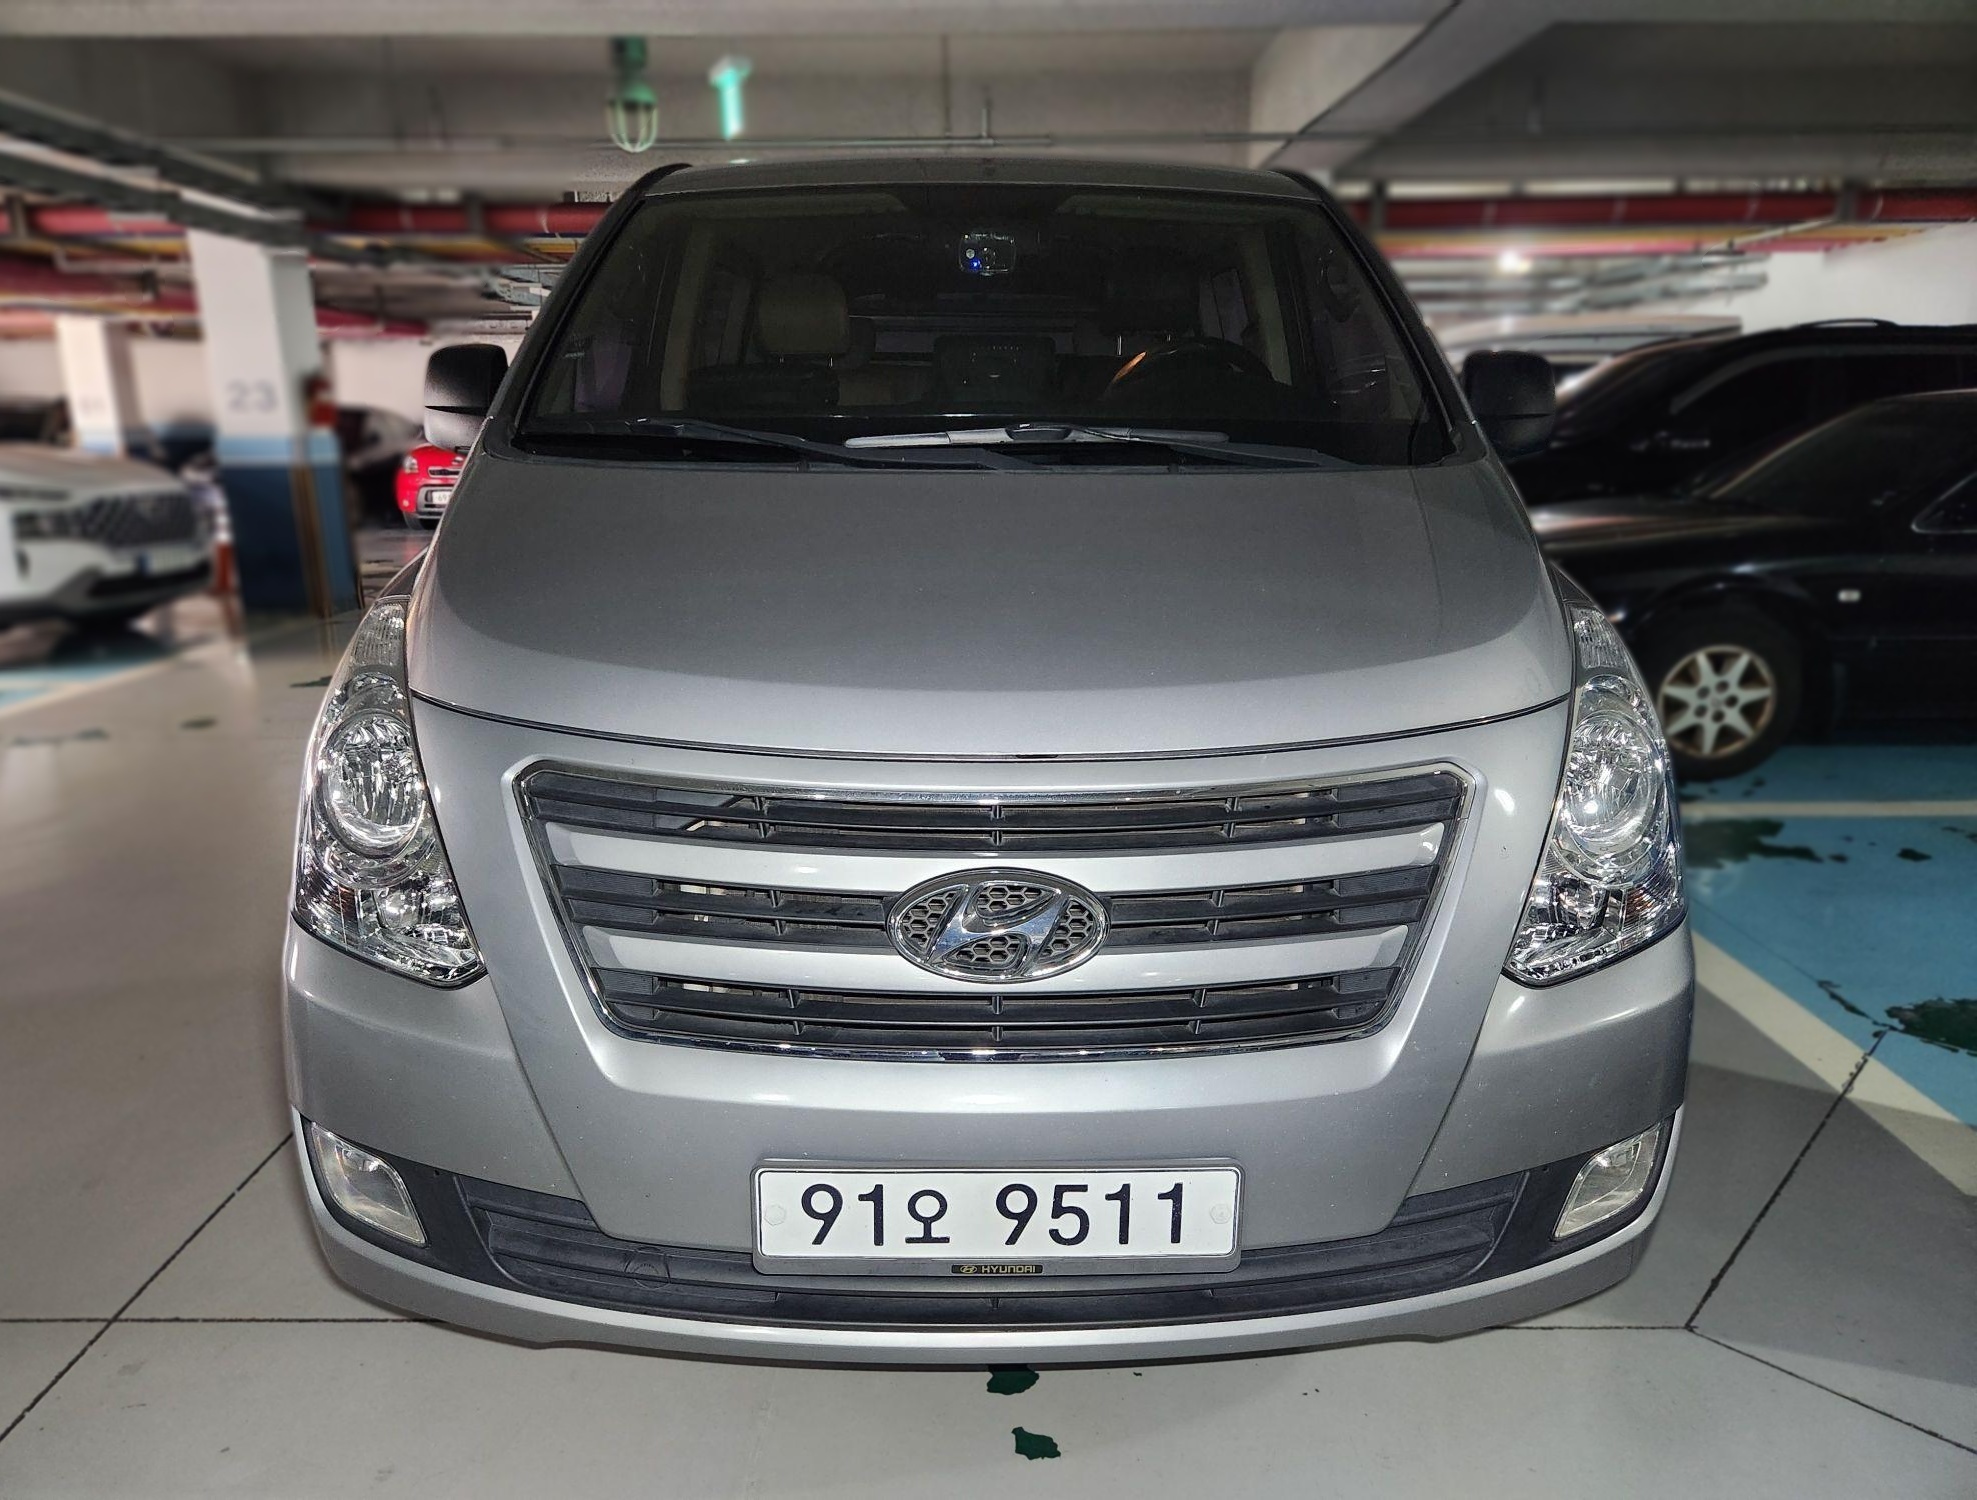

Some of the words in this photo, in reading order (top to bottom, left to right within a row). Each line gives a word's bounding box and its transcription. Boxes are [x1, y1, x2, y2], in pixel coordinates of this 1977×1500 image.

[802, 1184, 950, 1246] 91오
[996, 1183, 1182, 1246] 9511
[982, 1265, 1036, 1273] HYUNDAI
